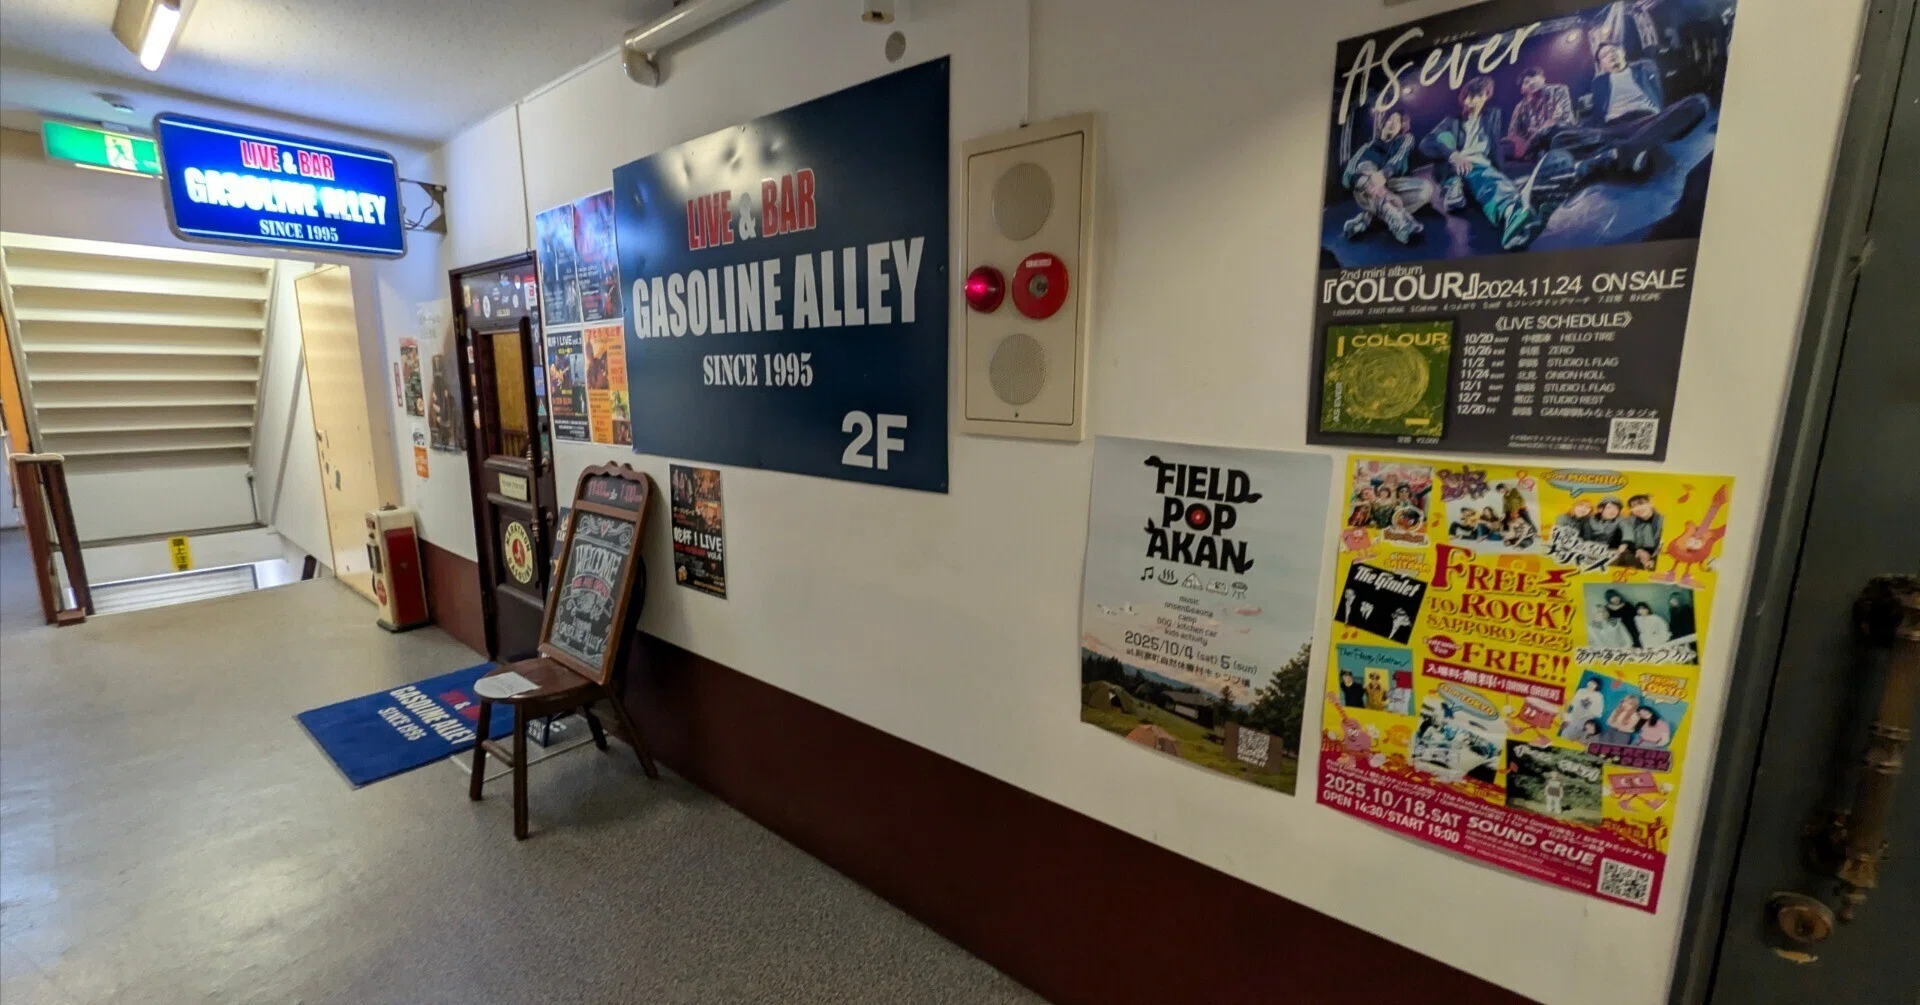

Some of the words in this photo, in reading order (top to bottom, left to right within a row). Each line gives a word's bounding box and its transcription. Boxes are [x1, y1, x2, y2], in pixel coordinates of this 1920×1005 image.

[1420, 22, 1542, 90] ever
[240, 140, 280, 172] LIVE
[282, 151, 297, 176] &
[298, 150, 334, 181] BAR
[184, 167, 319, 218] GASOLINE
[319, 185, 388, 226] ALLEY
[686, 190, 734, 251] LIVE
[738, 193, 756, 241] &
[761, 168, 816, 238] BAR
[259, 219, 303, 239] SINCE
[307, 224, 339, 243] 1995
[632, 257, 784, 339] GASOLINE
[793, 236, 925, 329] ALLEY
[1340, 269, 1361, 281] 2nd
[1362, 267, 1387, 279] mini
[1387, 265, 1423, 277] album
[1478, 274, 1583, 299] 2024.11.24
[1592, 272, 1628, 293] ON
[1629, 267, 1688, 291] SALE
[1351, 332, 1449, 348] COLOUR
[1463, 345, 1492, 356] 10/26
[1465, 333, 1494, 344] 10/20
[1560, 332, 1592, 342] HELLO
[703, 354, 757, 387] SINCE
[763, 352, 813, 388] 1995
[1460, 369, 1490, 380] 11/24
[1461, 357, 1485, 368] 11/2
[1458, 393, 1482, 403] 12/7
[1459, 381, 1481, 391] 12/1
[1457, 404, 1487, 415] 12/20
[841, 410, 908, 470] 2F
[1144, 455, 1263, 504] FIELD
[1162, 496, 1237, 536] POP
[700, 532, 722, 552] LIVE
[1144, 517, 1254, 575] AKAN
[1353, 566, 1376, 584] The
[1431, 543, 1540, 595] FREE
[1178, 595, 1199, 605] music
[1428, 596, 1457, 613] TO
[1460, 593, 1575, 634] ROCK!
[1124, 630, 1194, 660] 2025/10/4
[1427, 614, 1517, 643] SAPPORO
[1518, 630, 1573, 652] 2025
[389, 686, 451, 724] GASOLINE
[430, 719, 478, 744] ALLEY
[1322, 789, 1351, 808] OPEN
[1428, 824, 1459, 844] 15:00
[1466, 817, 1537, 847] SOUND
[1540, 840, 1597, 866] CRUE
